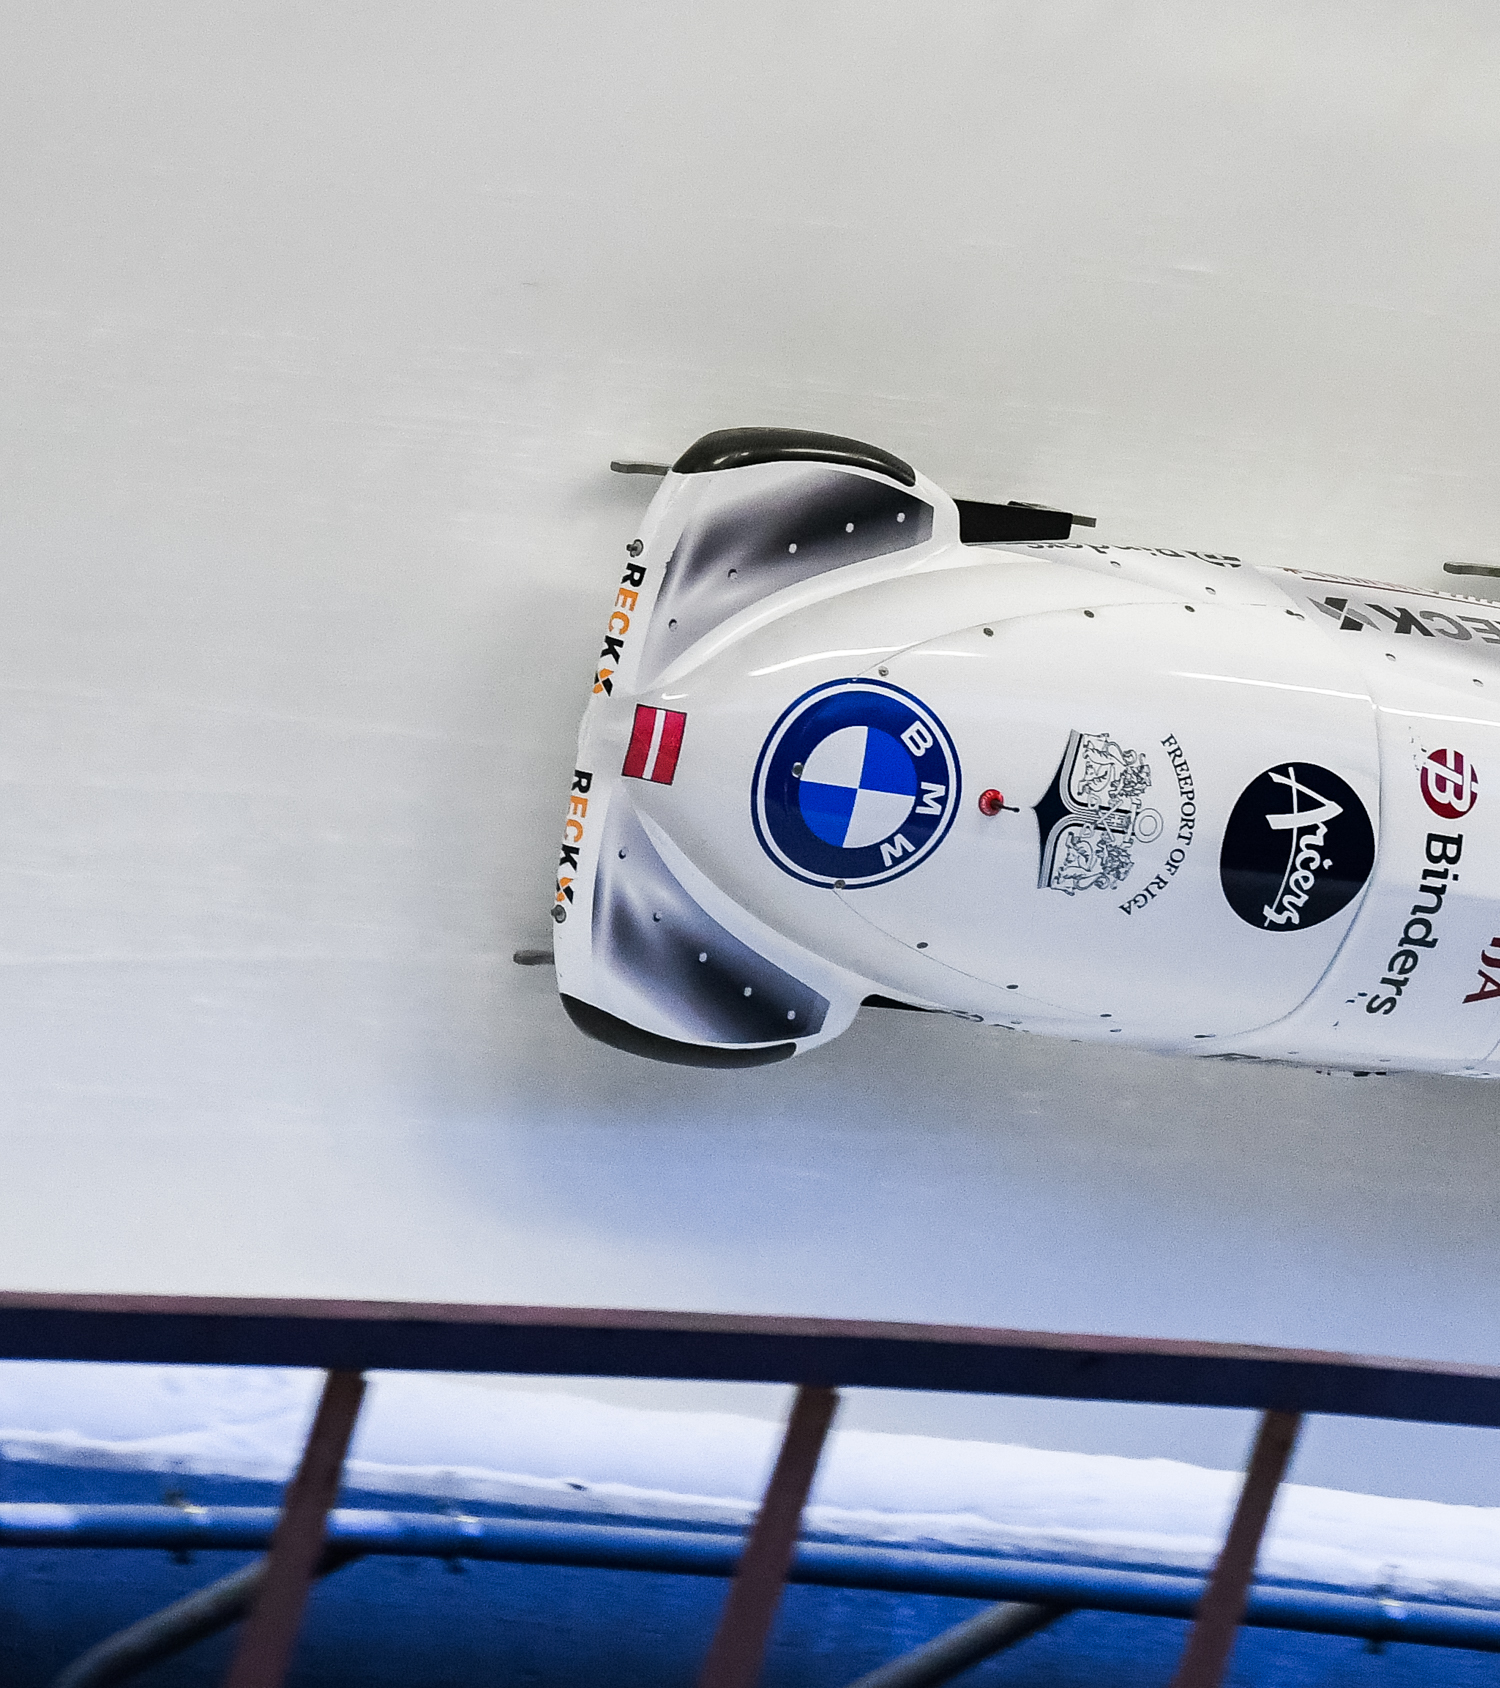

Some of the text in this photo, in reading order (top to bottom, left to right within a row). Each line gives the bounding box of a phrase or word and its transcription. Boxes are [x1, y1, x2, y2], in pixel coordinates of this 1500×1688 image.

[879, 720, 947, 868] BMW
[1117, 733, 1197, 916] FREEPORT OF RIGA
[1365, 833, 1464, 1016] Binders
